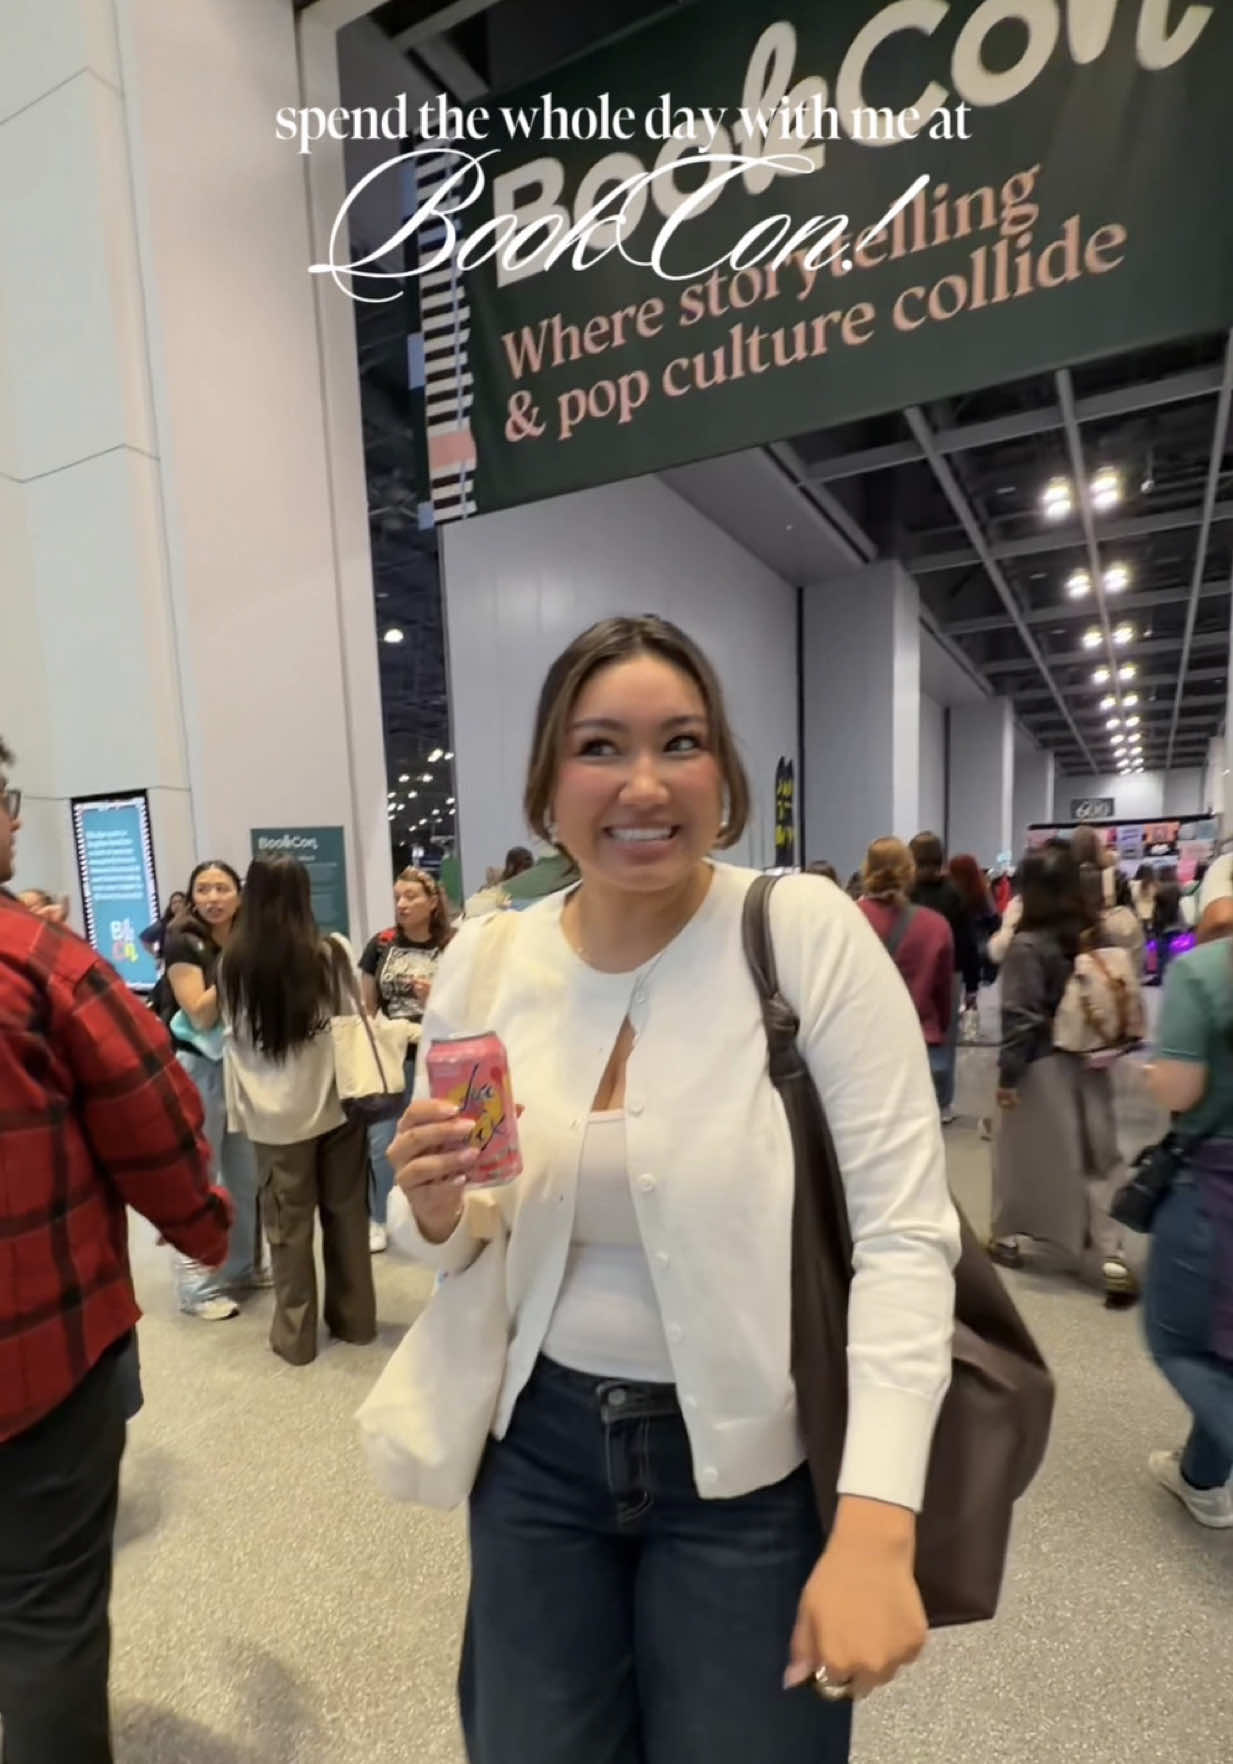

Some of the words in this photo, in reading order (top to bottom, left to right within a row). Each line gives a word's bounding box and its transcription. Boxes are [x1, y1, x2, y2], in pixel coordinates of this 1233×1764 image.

[502, 297, 665, 380] Where
[680, 163, 1043, 326] storytelling
[505, 390, 546, 442] &
[558, 370, 649, 440] pop
[662, 302, 876, 398] culture
[893, 213, 1127, 331] collide
